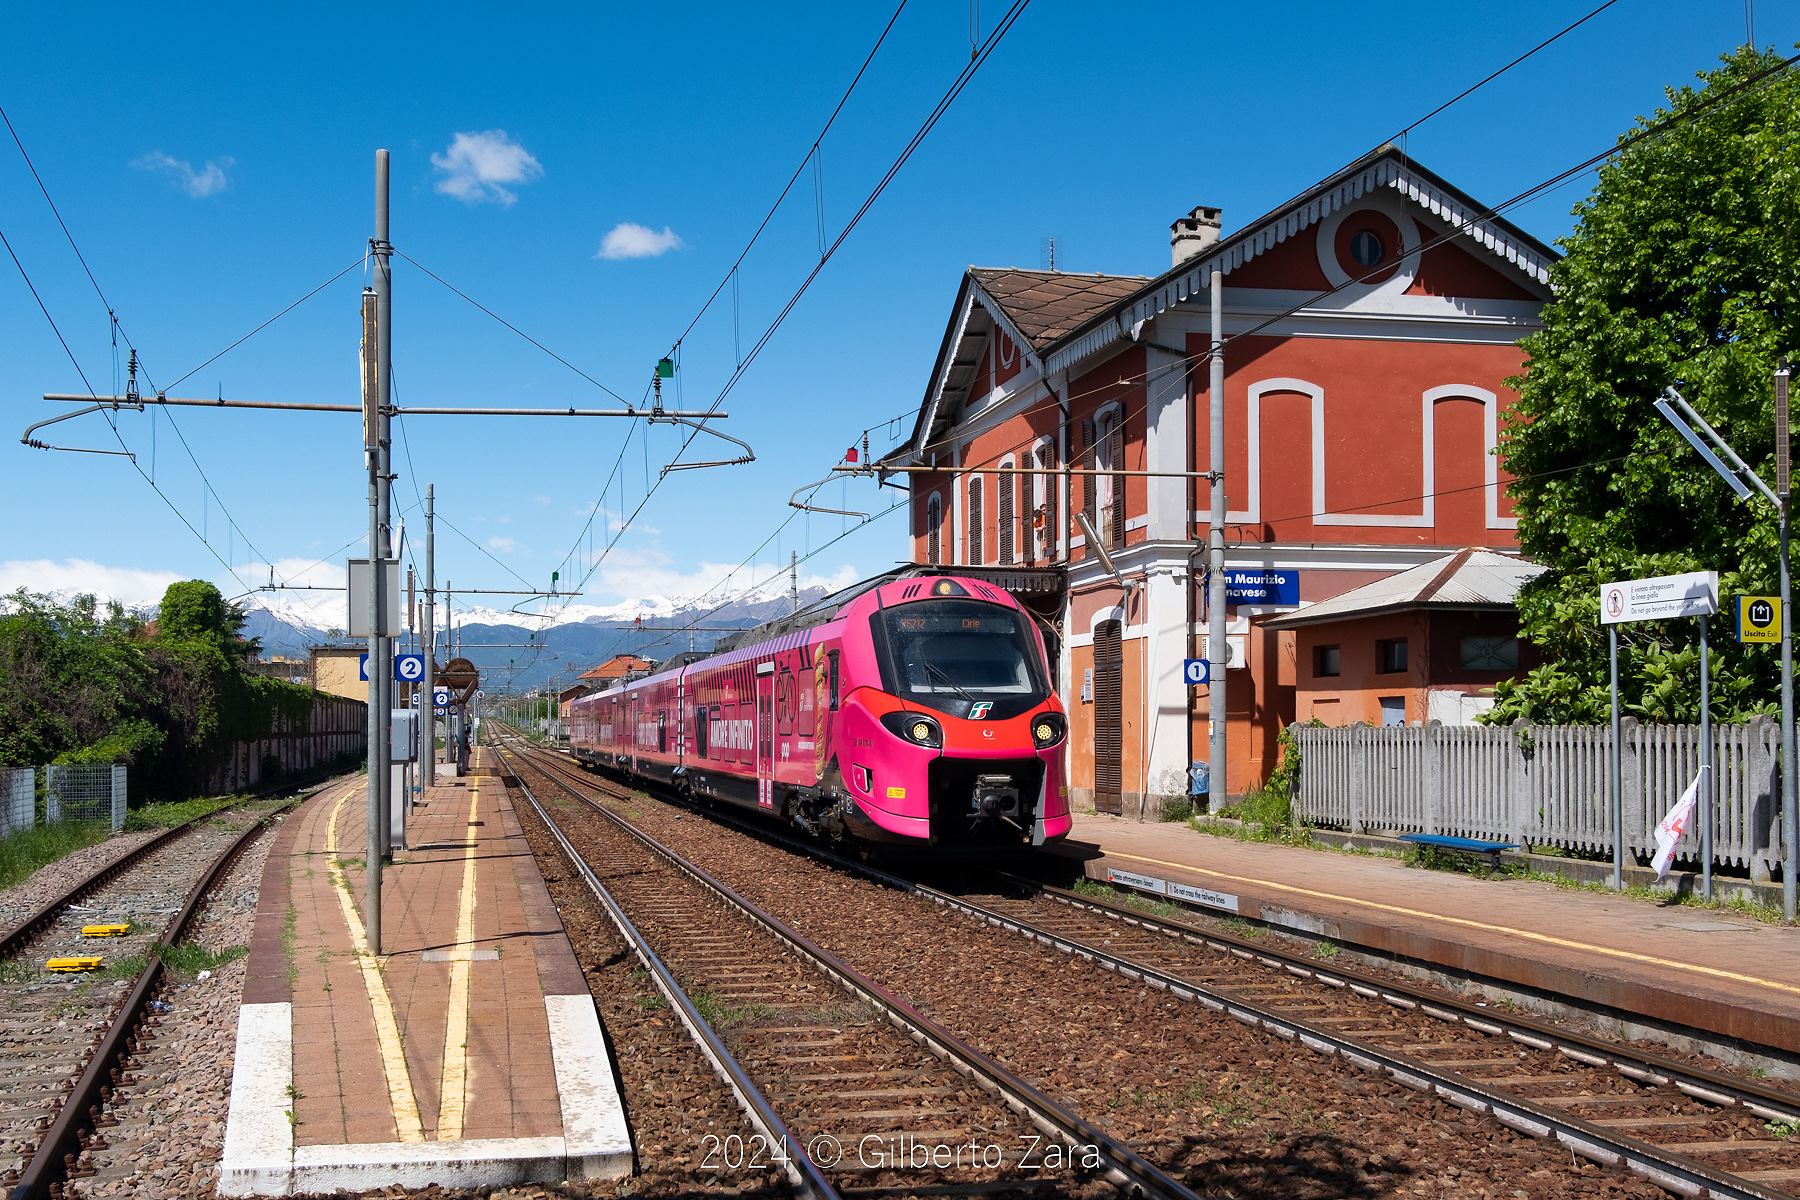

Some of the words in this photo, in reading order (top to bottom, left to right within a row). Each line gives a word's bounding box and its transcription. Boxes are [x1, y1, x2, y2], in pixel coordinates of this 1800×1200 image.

[1235, 574, 1286, 584] Maurizio
[1225, 588, 1267, 597] navese
[1634, 585, 1648, 593] vietato
[1649, 583, 1675, 591] oltrepassare
[1647, 592, 1659, 600] gialla
[1631, 607, 1637, 615] Do
[1645, 607, 1651, 615] go
[1652, 605, 1668, 614] beyond
[405, 661, 416, 675] 2
[1194, 665, 1199, 678] 1
[413, 695, 419, 703] 3
[709, 719, 728, 748] AMORE
[1215, 893, 1226, 905] lines
